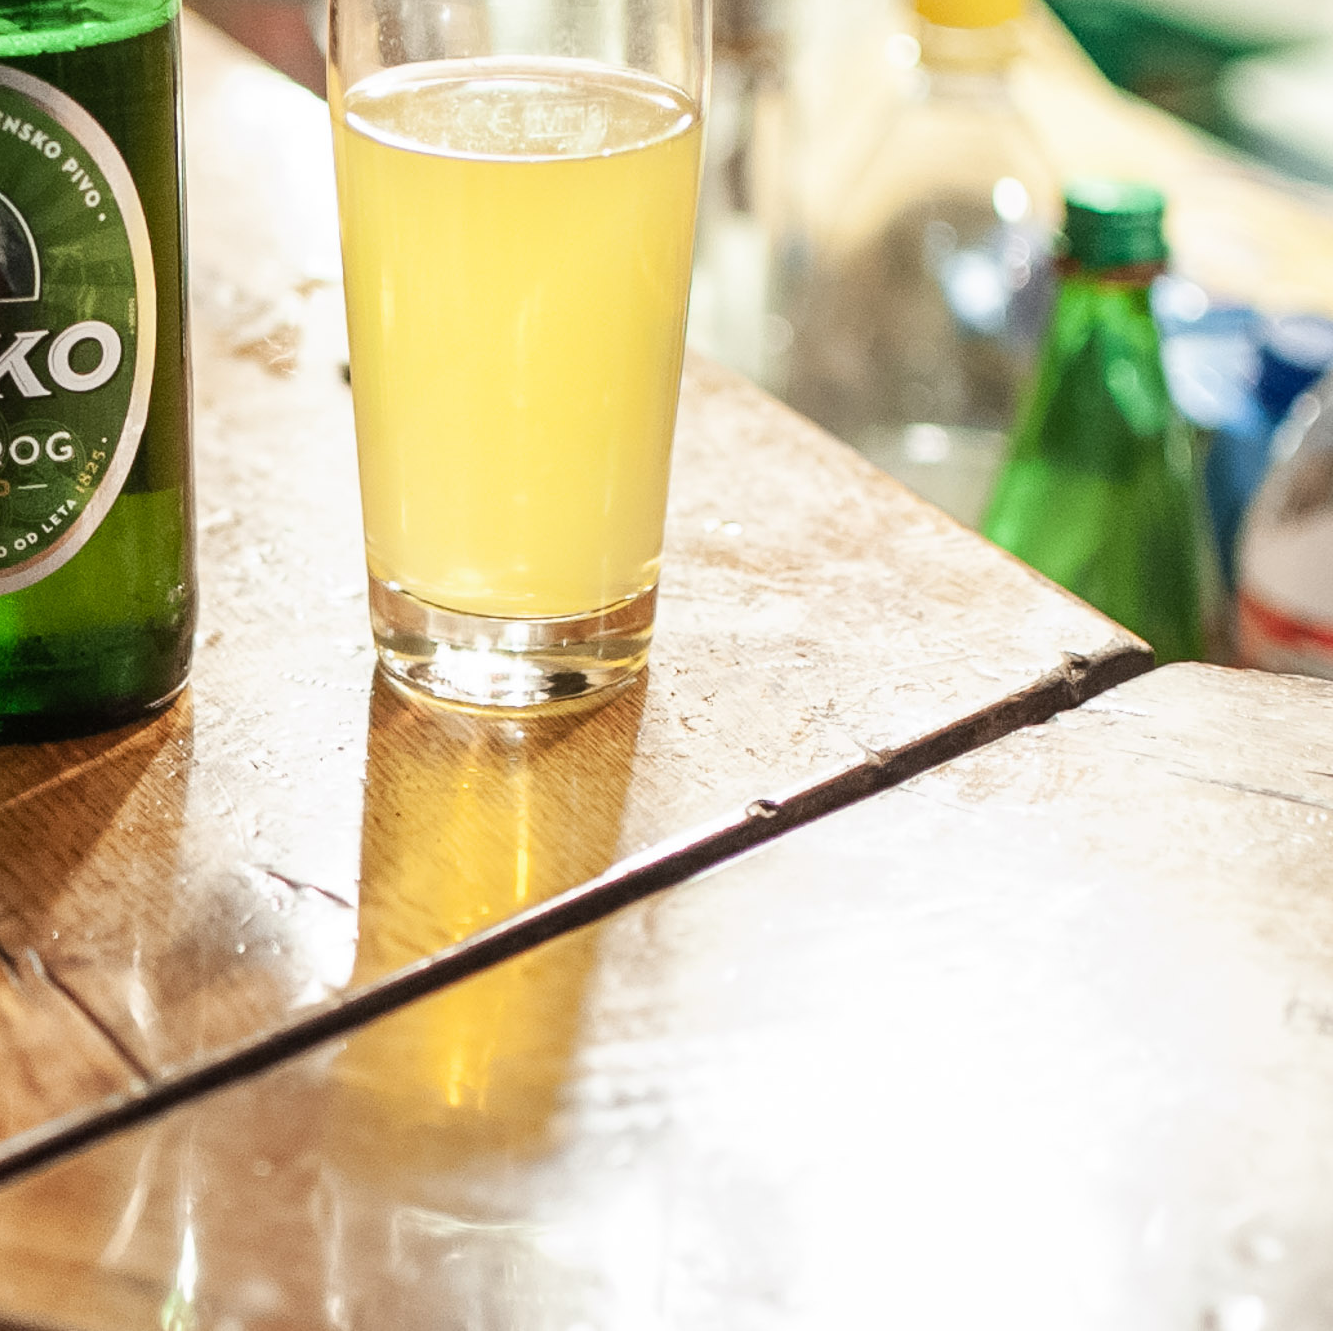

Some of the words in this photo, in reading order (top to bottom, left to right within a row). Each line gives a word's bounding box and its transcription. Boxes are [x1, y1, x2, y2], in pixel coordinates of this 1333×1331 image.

[61, 157, 101, 208] PIVO
[13, 532, 39, 552] OD
[41, 498, 77, 534] LETA
[75, 448, 107, 494] 1825
